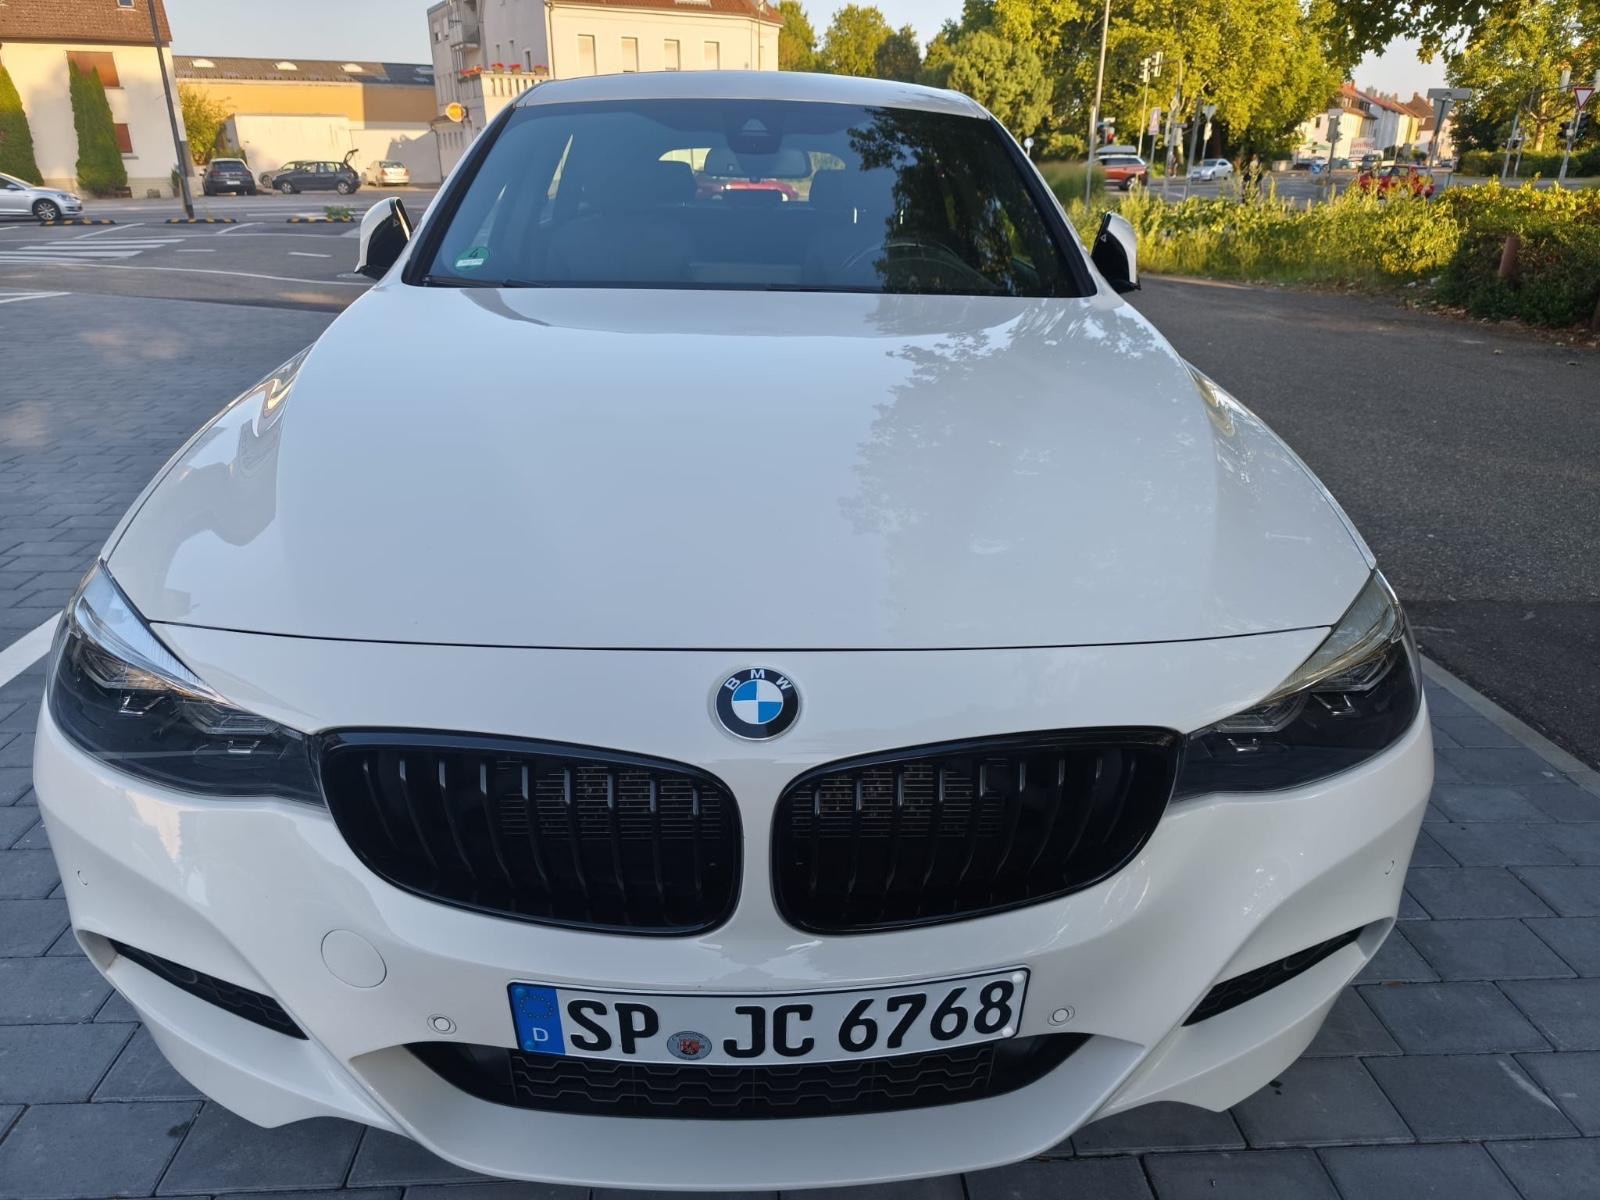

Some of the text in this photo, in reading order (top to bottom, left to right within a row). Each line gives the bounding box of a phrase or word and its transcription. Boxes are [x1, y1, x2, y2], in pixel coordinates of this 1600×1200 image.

[724, 669, 792, 690] BMW
[566, 999, 659, 1054] SP
[723, 1003, 814, 1058] JC
[837, 980, 1015, 1052] 6768
[532, 1026, 550, 1042] D
